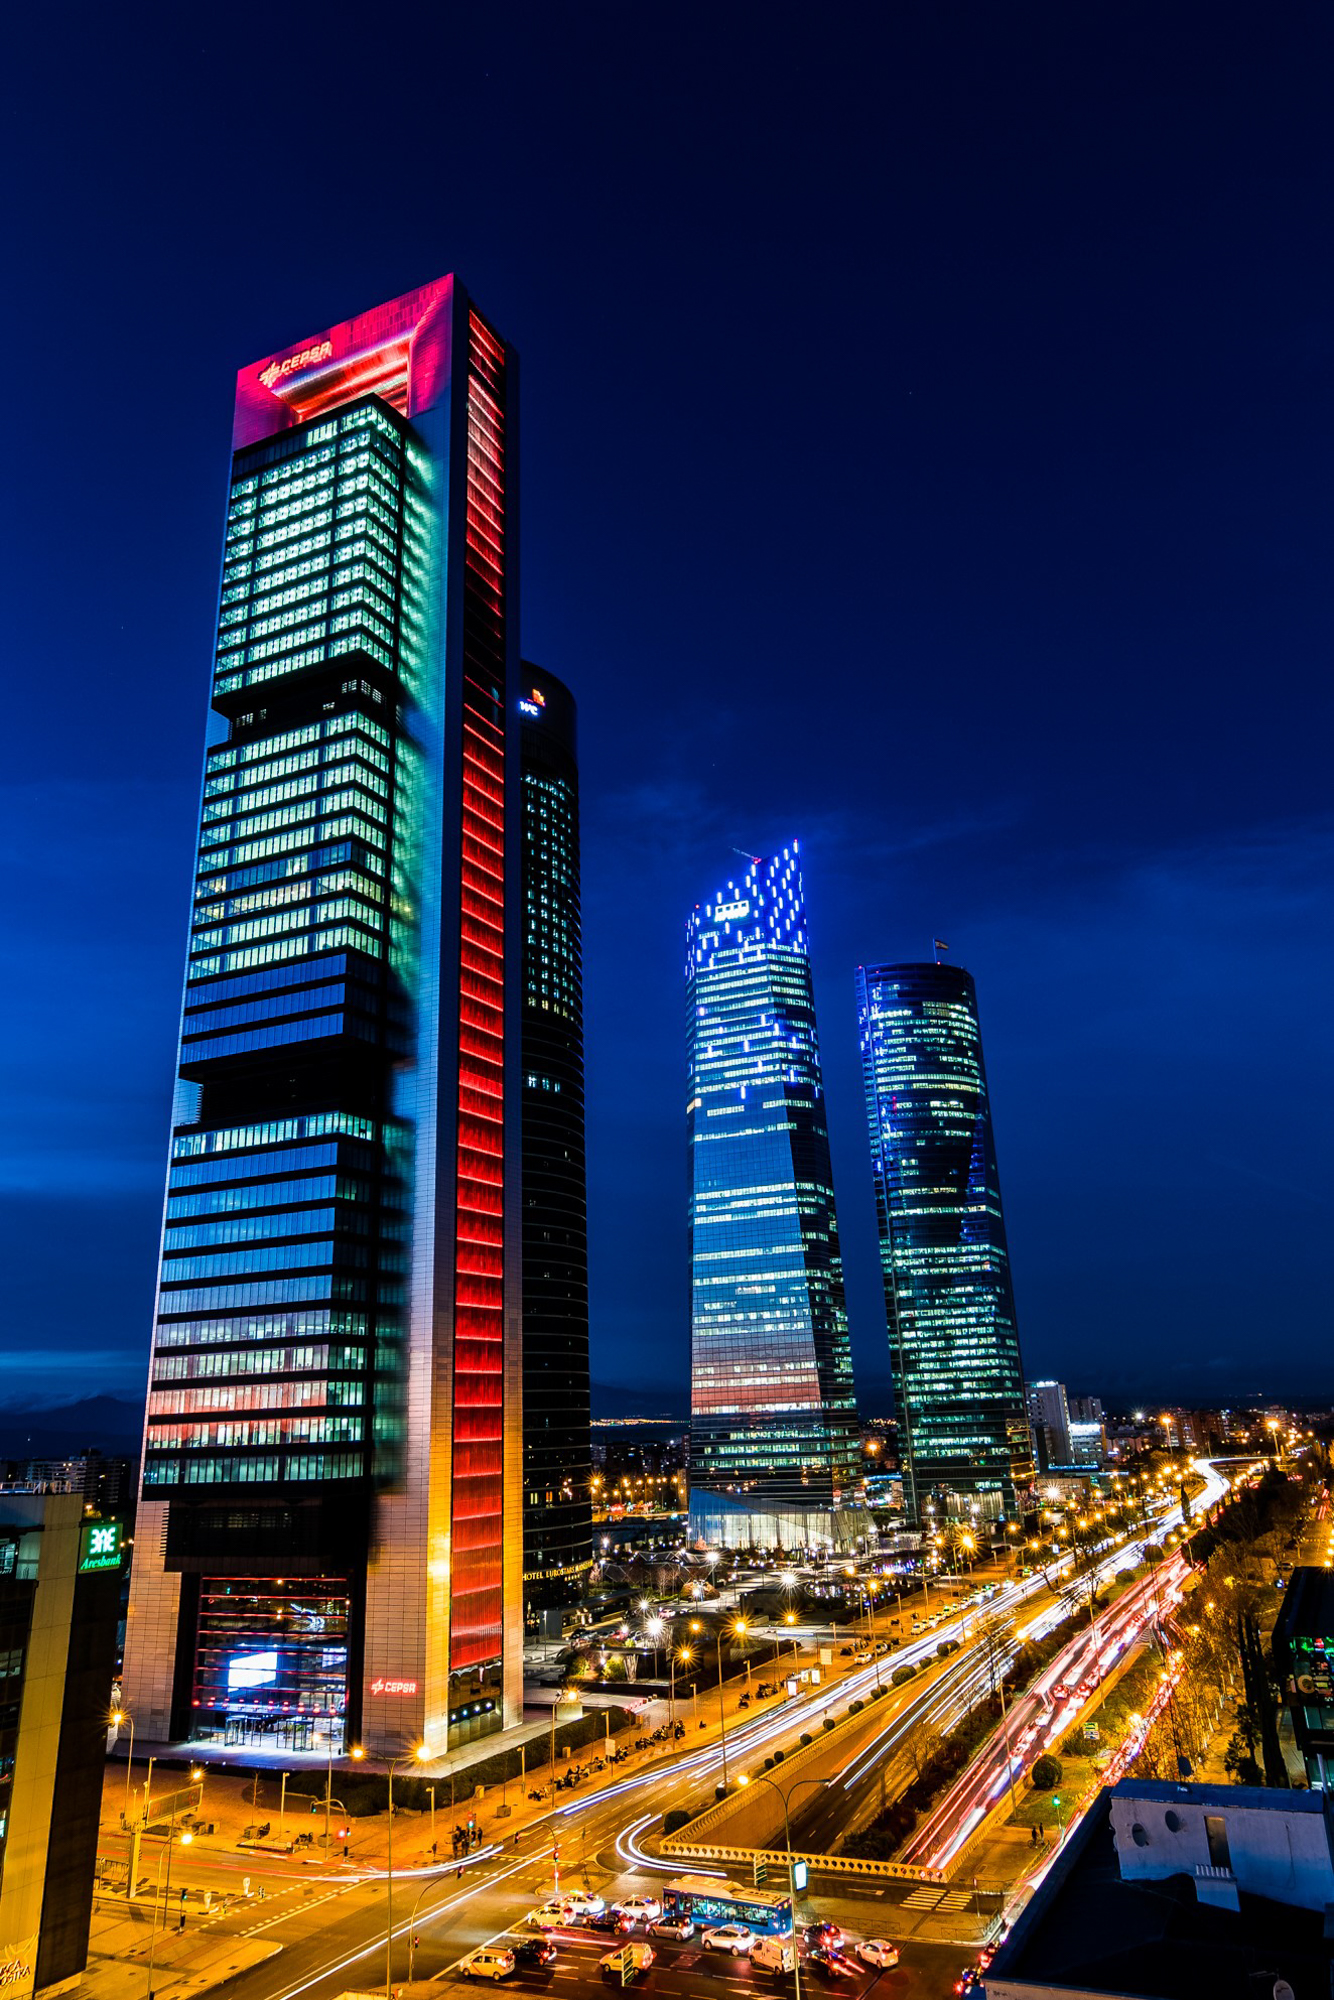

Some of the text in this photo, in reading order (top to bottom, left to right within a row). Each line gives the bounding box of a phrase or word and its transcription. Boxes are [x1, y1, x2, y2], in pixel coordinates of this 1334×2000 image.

[281, 341, 333, 375] CEPSA
[81, 1554, 121, 1570] Aresbank
[522, 1571, 543, 1581] HOTEL
[385, 1681, 416, 1693] CEPSA
